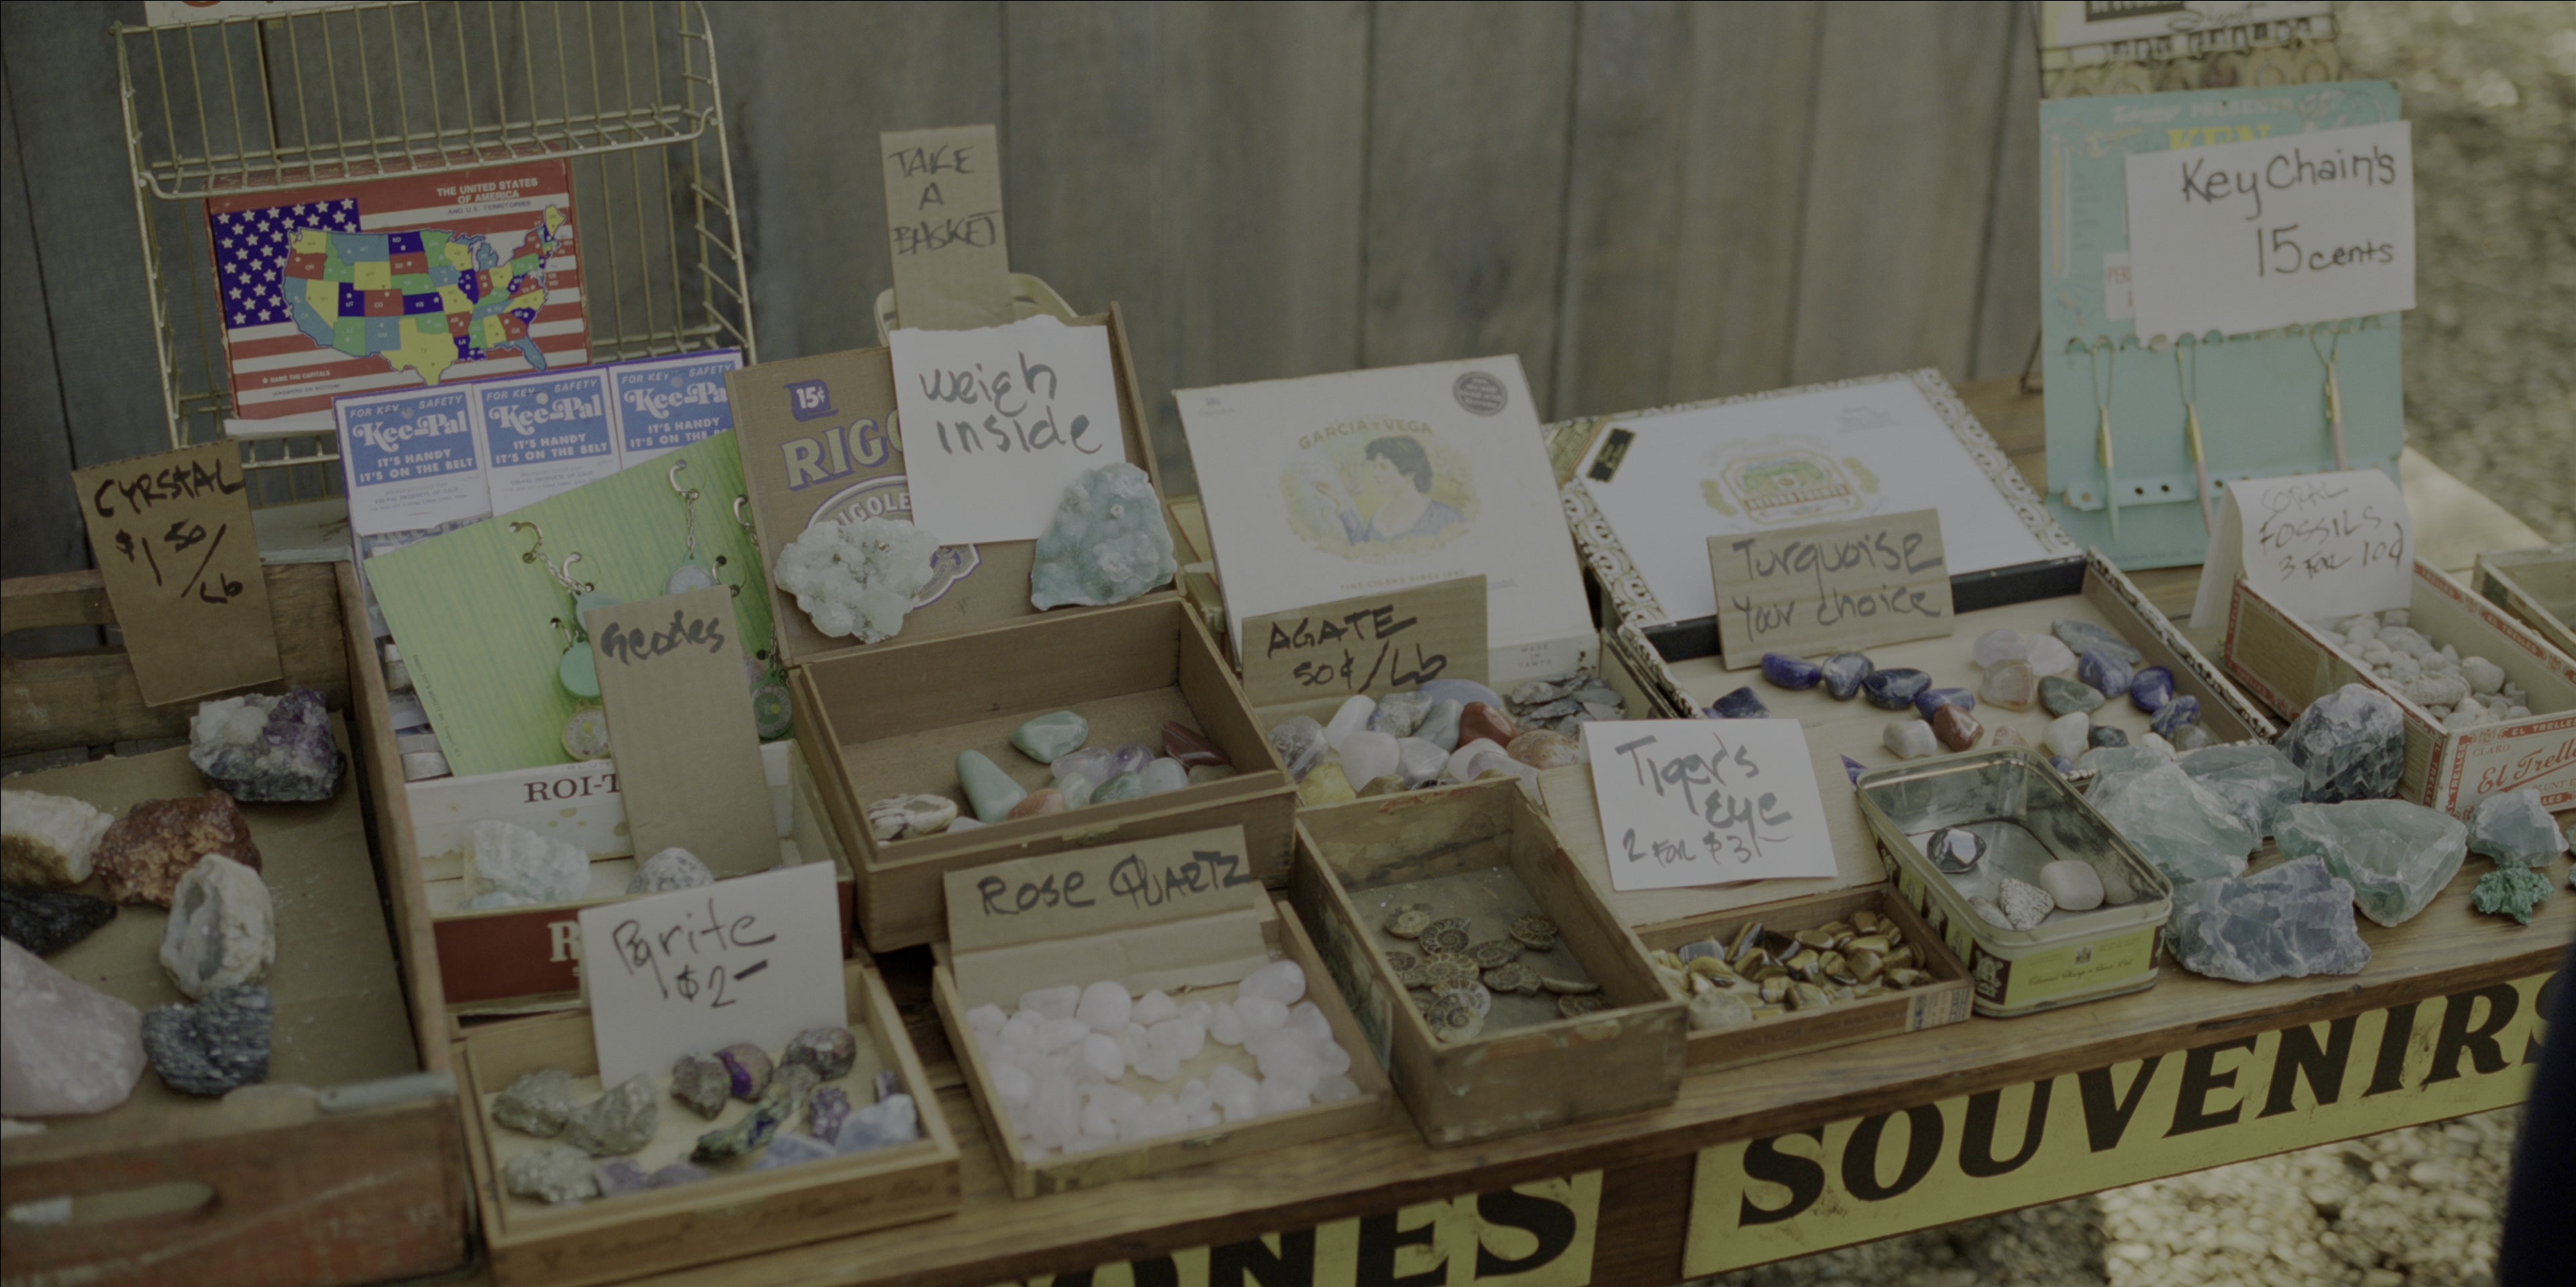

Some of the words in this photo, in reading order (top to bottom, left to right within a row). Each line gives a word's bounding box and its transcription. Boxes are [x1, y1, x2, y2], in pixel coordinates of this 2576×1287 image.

[887, 145, 977, 178] TAKE
[437, 186, 457, 197] THE
[459, 182, 497, 195] UNITED
[499, 178, 538, 191] STATES
[458, 194, 473, 204] OF
[475, 190, 520, 203] AMERICA
[919, 182, 945, 210] A
[483, 200, 532, 211] TERRITORIES
[891, 210, 1004, 255] BASKET
[2256, 224, 2303, 277] 15
[2308, 242, 2394, 270] cents
[270, 376, 288, 384] NAME
[289, 373, 301, 381] THE
[302, 370, 331, 380] CAPITALS
[487, 391, 509, 401] FOR
[513, 387, 536, 399] KEY
[554, 378, 597, 393] SAFETY
[622, 374, 644, 385] FOR
[648, 372, 670, 382] KEY
[689, 364, 732, 378] SAFETY
[919, 350, 1058, 418] weigh
[350, 408, 372, 419] FOR
[377, 404, 401, 415] KEY
[418, 395, 464, 409] SAFETY
[624, 381, 729, 420] Kee-Pa
[796, 385, 826, 410] 15¢
[488, 393, 603, 435] Kee-Pal
[648, 423, 671, 435] IT'S
[675, 417, 720, 431] HANDY
[352, 409, 468, 453] Kee-Pal
[513, 439, 536, 451] IT'S
[540, 433, 587, 448] HANDY
[630, 437, 654, 448] IT'S
[659, 434, 680, 444] ON
[936, 405, 1104, 456] inside
[1298, 419, 1369, 450] GARCIA
[1383, 418, 1434, 436] VEGA
[378, 456, 401, 468] IT'S
[405, 448, 452, 464] HANDY
[495, 454, 519, 465] IT'S
[525, 450, 546, 460] ON
[552, 445, 577, 458] THE
[581, 442, 607, 455] BELT
[360, 471, 383, 483] IT'S
[389, 467, 410, 478] ON
[415, 462, 440, 474] THE
[446, 457, 473, 470] BELT
[838, 491, 911, 525] IGOLE
[2259, 505, 2382, 556] FOSSILS
[1732, 531, 1942, 600] Turquoise
[2278, 554, 2296, 582] 3
[1267, 603, 1418, 660] AGATE
[1732, 594, 1796, 642] Your
[2512, 727, 2526, 737] EL
[2532, 717, 2576, 733] TRELLES
[2472, 743, 2511, 758] CLARO
[523, 772, 621, 804] ROI-T
[1614, 731, 1760, 817] Tiger's
[2424, 760, 2440, 805] TRELLE
[2477, 763, 2510, 795] El
[1622, 827, 1648, 862] 2
[1109, 850, 1254, 911] QUARTZ
